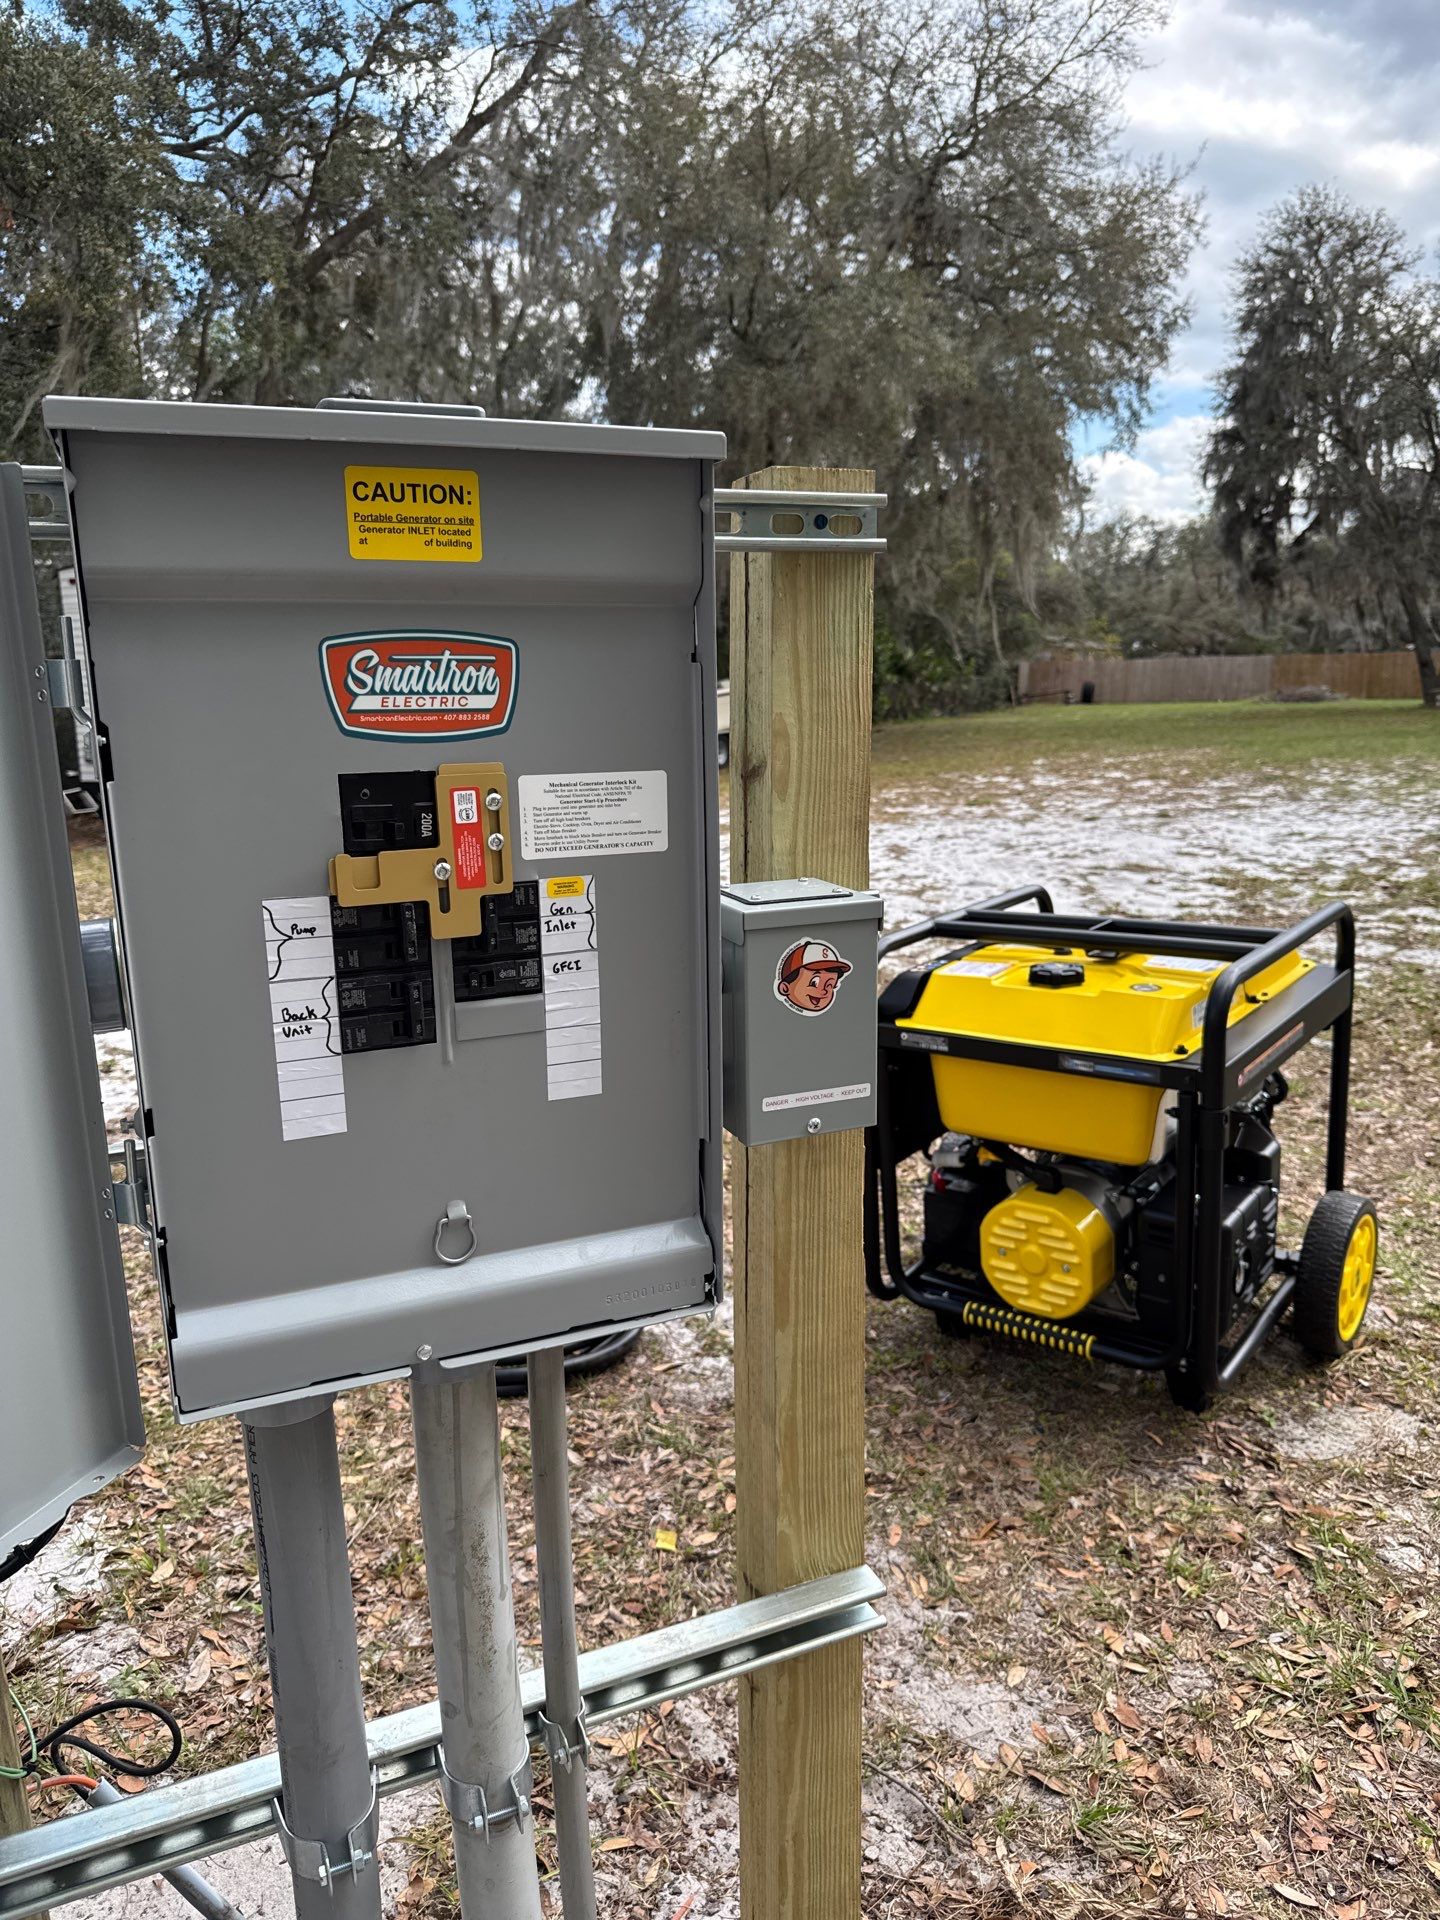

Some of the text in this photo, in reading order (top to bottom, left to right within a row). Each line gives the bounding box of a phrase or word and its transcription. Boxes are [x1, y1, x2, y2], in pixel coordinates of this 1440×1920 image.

[352, 480, 472, 506] CAUTION:
[353, 512, 475, 526] Portable Generator on site
[358, 524, 472, 537] Generator INLET located
[358, 536, 473, 550] at of building
[347, 648, 500, 695] Smartron
[380, 696, 470, 708] ELECTRIC
[359, 714, 438, 723] SmartronElectric.com
[421, 812, 433, 838] 200A
[558, 844, 583, 852] EXCEED
[625, 840, 655, 848] CAPACITY
[290, 922, 317, 937] Pump
[544, 918, 577, 933] Inlet
[822, 947, 829, 959] S
[552, 959, 582, 974] GFCI
[281, 1005, 318, 1023] Back
[281, 1024, 313, 1038] Unit
[765, 1098, 789, 1108] DANGER
[795, 1095, 810, 1104] HIGH
[810, 1092, 834, 1101] VOLTAGE
[841, 1088, 856, 1096] KEEP
[856, 1086, 868, 1094] OUT
